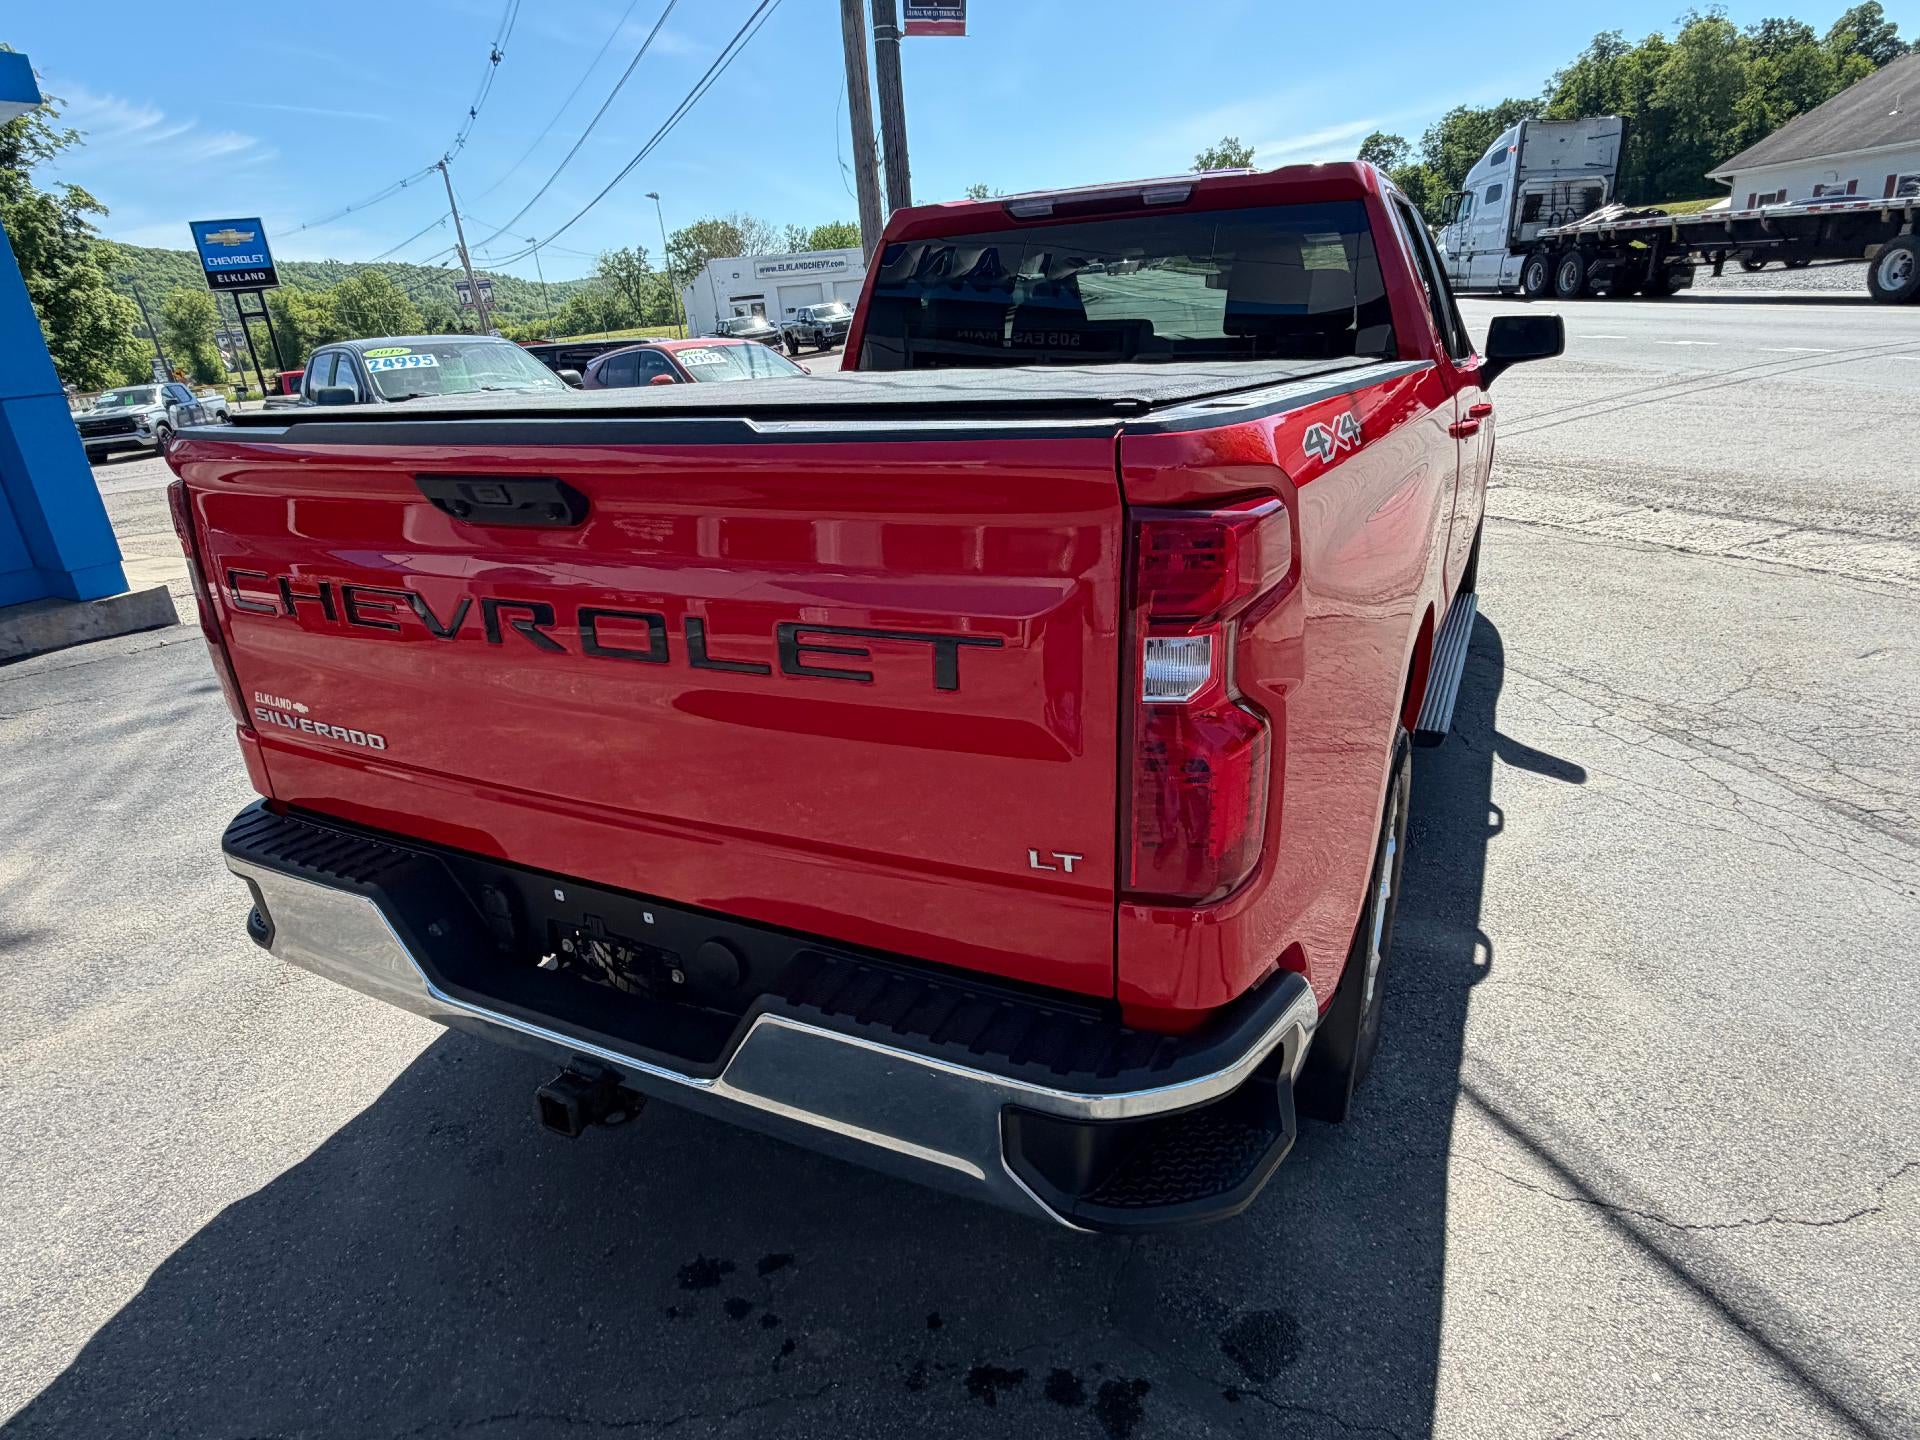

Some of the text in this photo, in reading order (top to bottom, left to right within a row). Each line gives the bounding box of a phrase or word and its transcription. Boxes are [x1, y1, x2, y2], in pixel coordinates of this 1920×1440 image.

[207, 254, 264, 266] CHEVROLET
[759, 260, 845, 274] www.ELKLANDCHEVY.com
[216, 272, 266, 283] ELKLAND
[368, 356, 434, 372] 24995
[1302, 411, 1362, 464] 4X4
[226, 567, 1004, 691] CHEVROLET
[254, 691, 292, 711] ELKLAND
[254, 707, 387, 750] SILVERADO
[1027, 848, 1083, 873] LT
